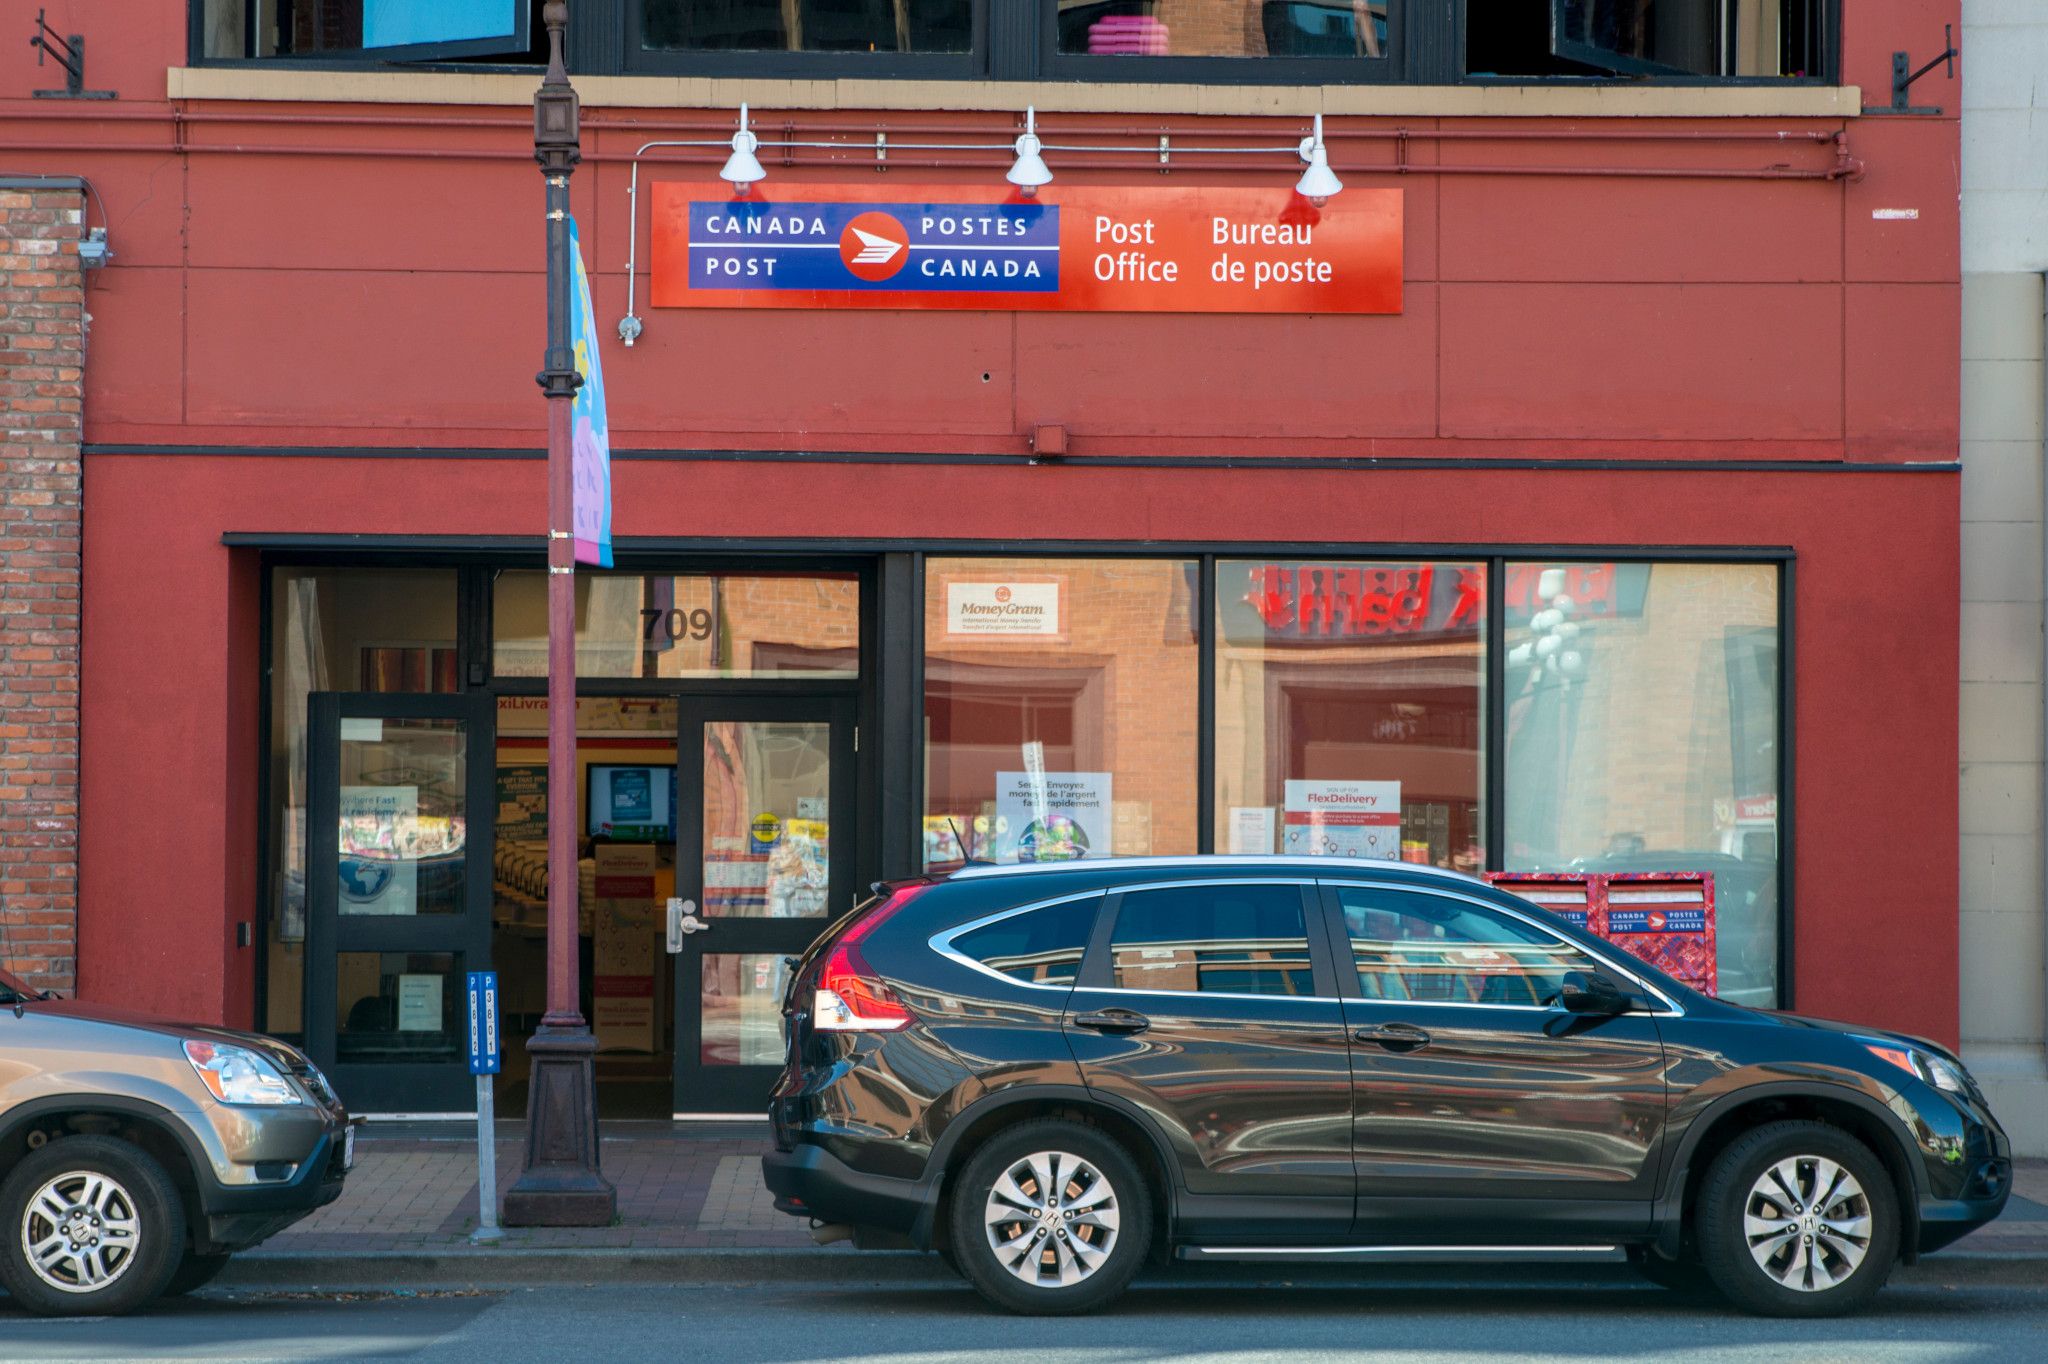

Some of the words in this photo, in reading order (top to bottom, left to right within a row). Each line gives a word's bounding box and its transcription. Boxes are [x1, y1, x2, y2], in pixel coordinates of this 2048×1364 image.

[705, 216, 827, 236] CANADA
[921, 217, 1027, 236] POSTES
[1094, 216, 1155, 245] Post
[1212, 217, 1312, 245] Bureau
[706, 257, 778, 277] POST
[920, 259, 1042, 278] CANADA
[1093, 252, 1178, 282] Office
[1211, 253, 1246, 283] de
[1254, 256, 1333, 290] poste
[960, 602, 1044, 617] MoneyGram
[640, 608, 714, 641] 709
[1046, 781, 1085, 791] Envoyez
[1046, 790, 1058, 798] de
[1060, 790, 1097, 800] l'argent
[1047, 799, 1100, 809] rapidement
[1307, 793, 1377, 806] FlexDelivery
[470, 976, 476, 987] P
[485, 976, 492, 987] P
